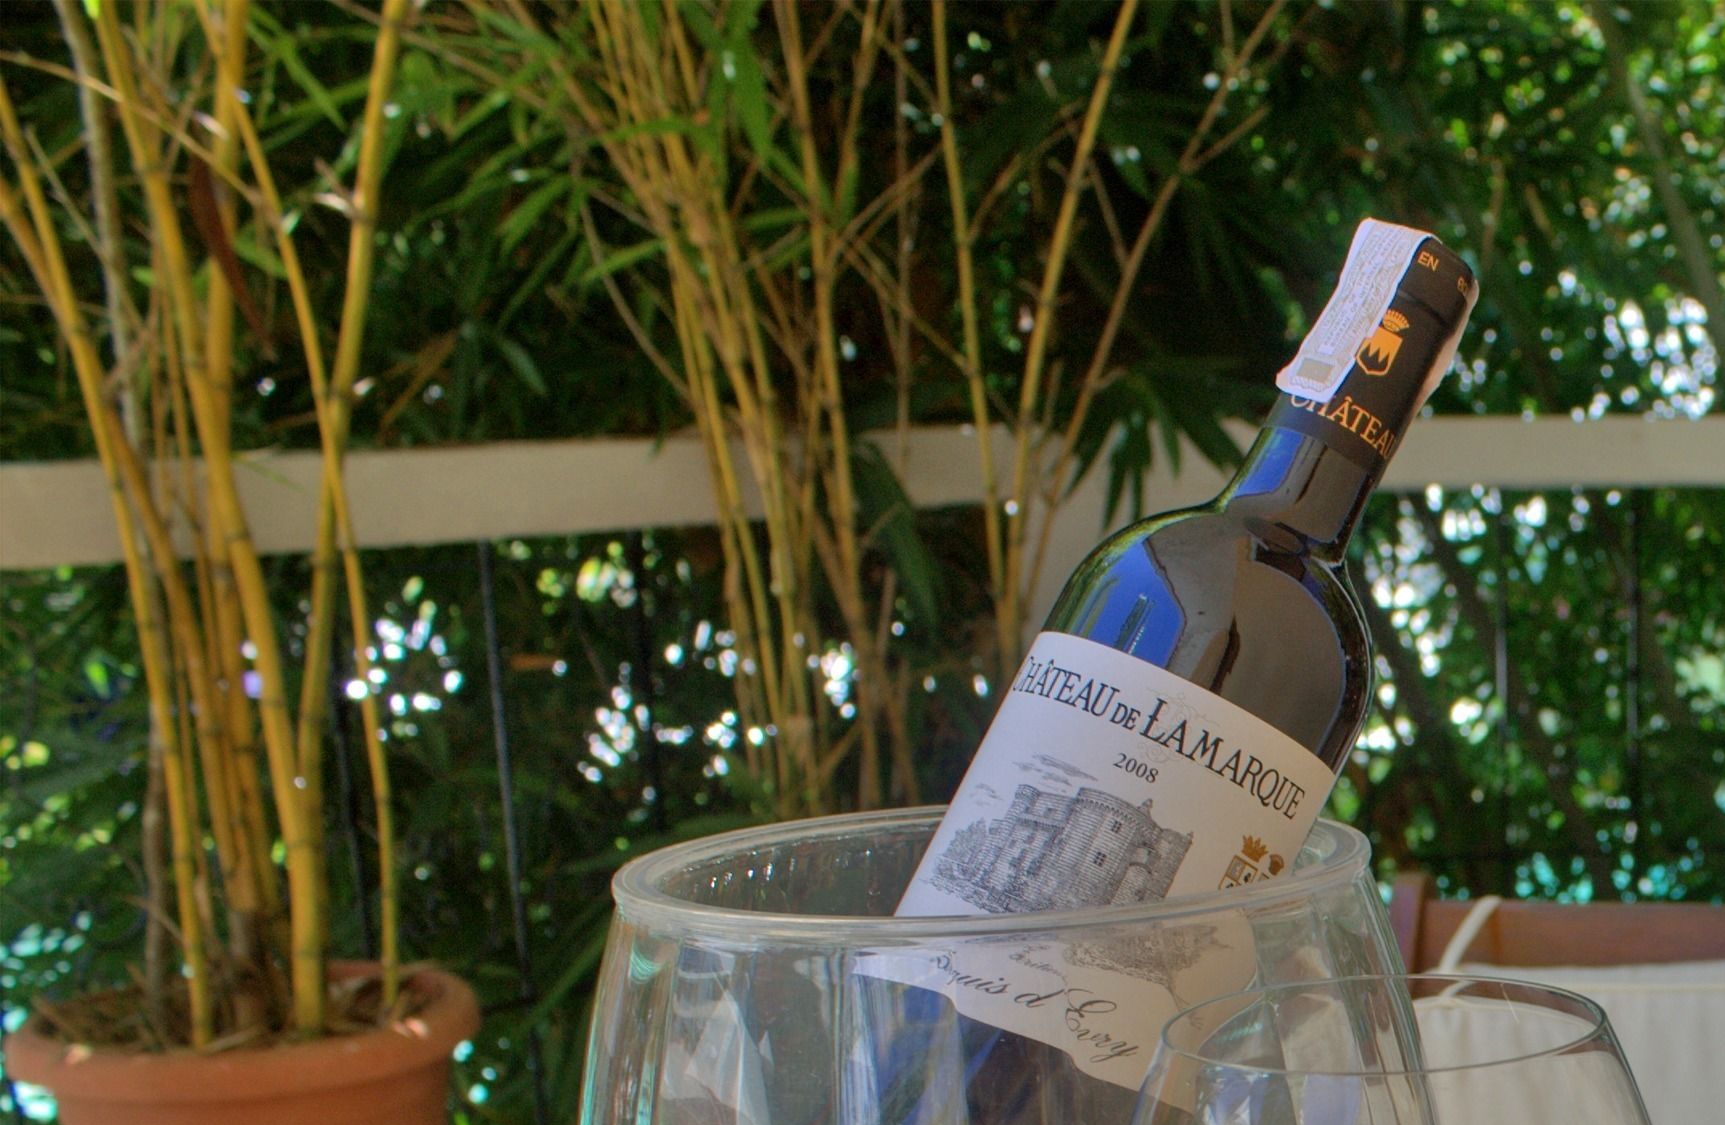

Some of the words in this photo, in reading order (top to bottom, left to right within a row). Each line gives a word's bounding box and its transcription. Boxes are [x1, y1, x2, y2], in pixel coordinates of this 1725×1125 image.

[1418, 250, 1439, 271] EN
[1109, 702, 1141, 730] DE
[1139, 698, 1305, 820] LAMARQUE
[1113, 752, 1159, 784] 2008
